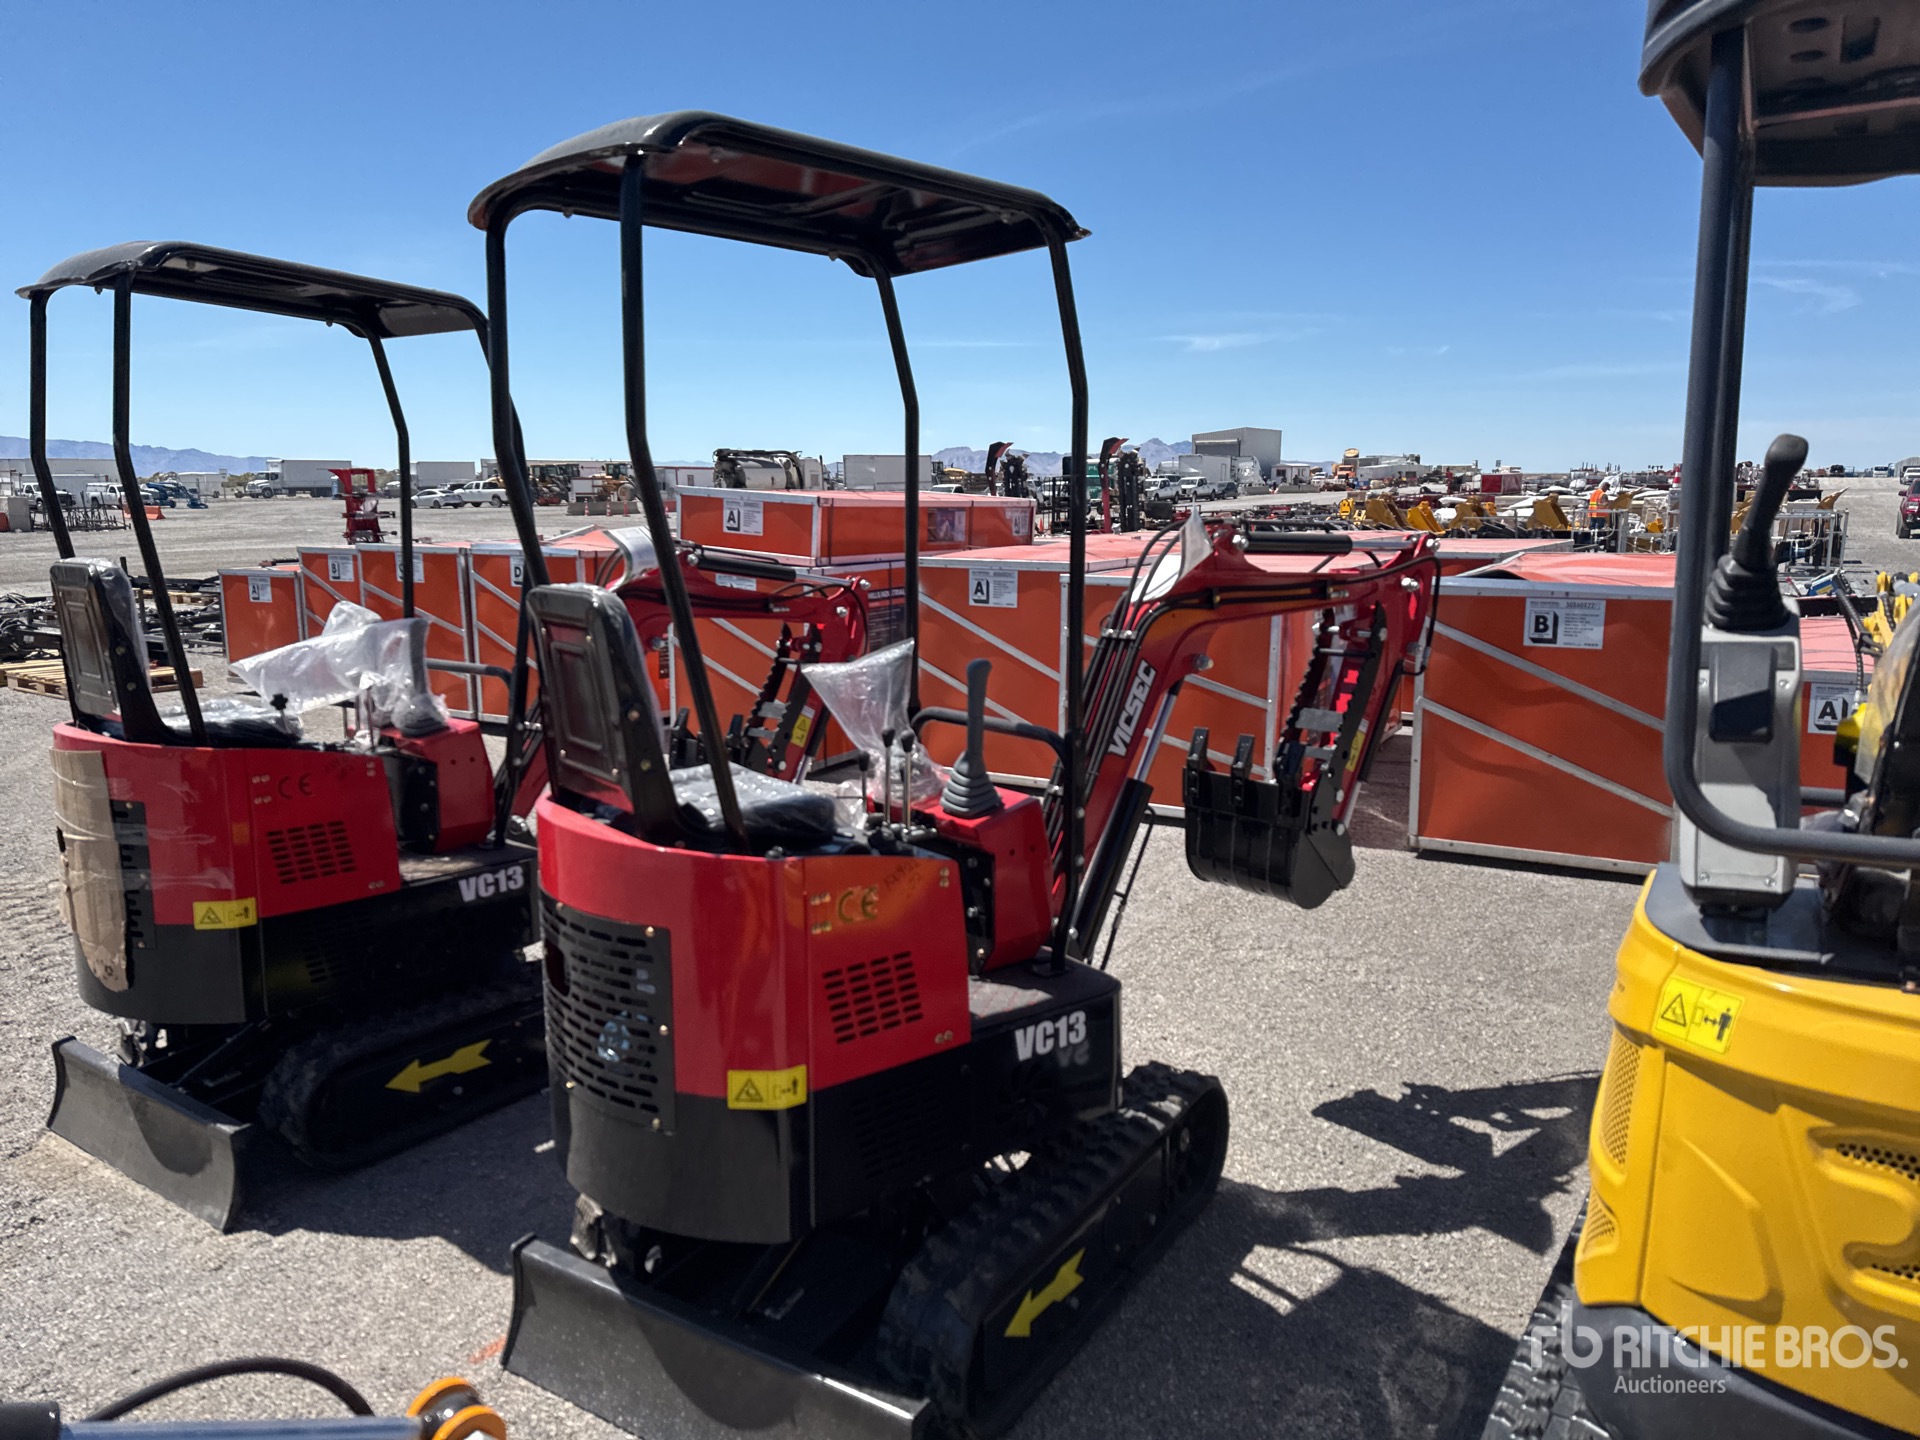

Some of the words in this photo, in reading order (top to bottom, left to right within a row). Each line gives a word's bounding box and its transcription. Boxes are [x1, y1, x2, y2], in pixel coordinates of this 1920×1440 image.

[727, 510, 737, 524] A
[331, 563, 338, 574] B
[514, 566, 522, 578] D
[252, 585, 258, 595] A
[973, 580, 986, 596] A
[1534, 614, 1550, 633] B
[1107, 659, 1157, 757] VICSEC
[1818, 700, 1838, 720] A
[457, 865, 525, 903] VC13
[1014, 1010, 1087, 1062] VC13
